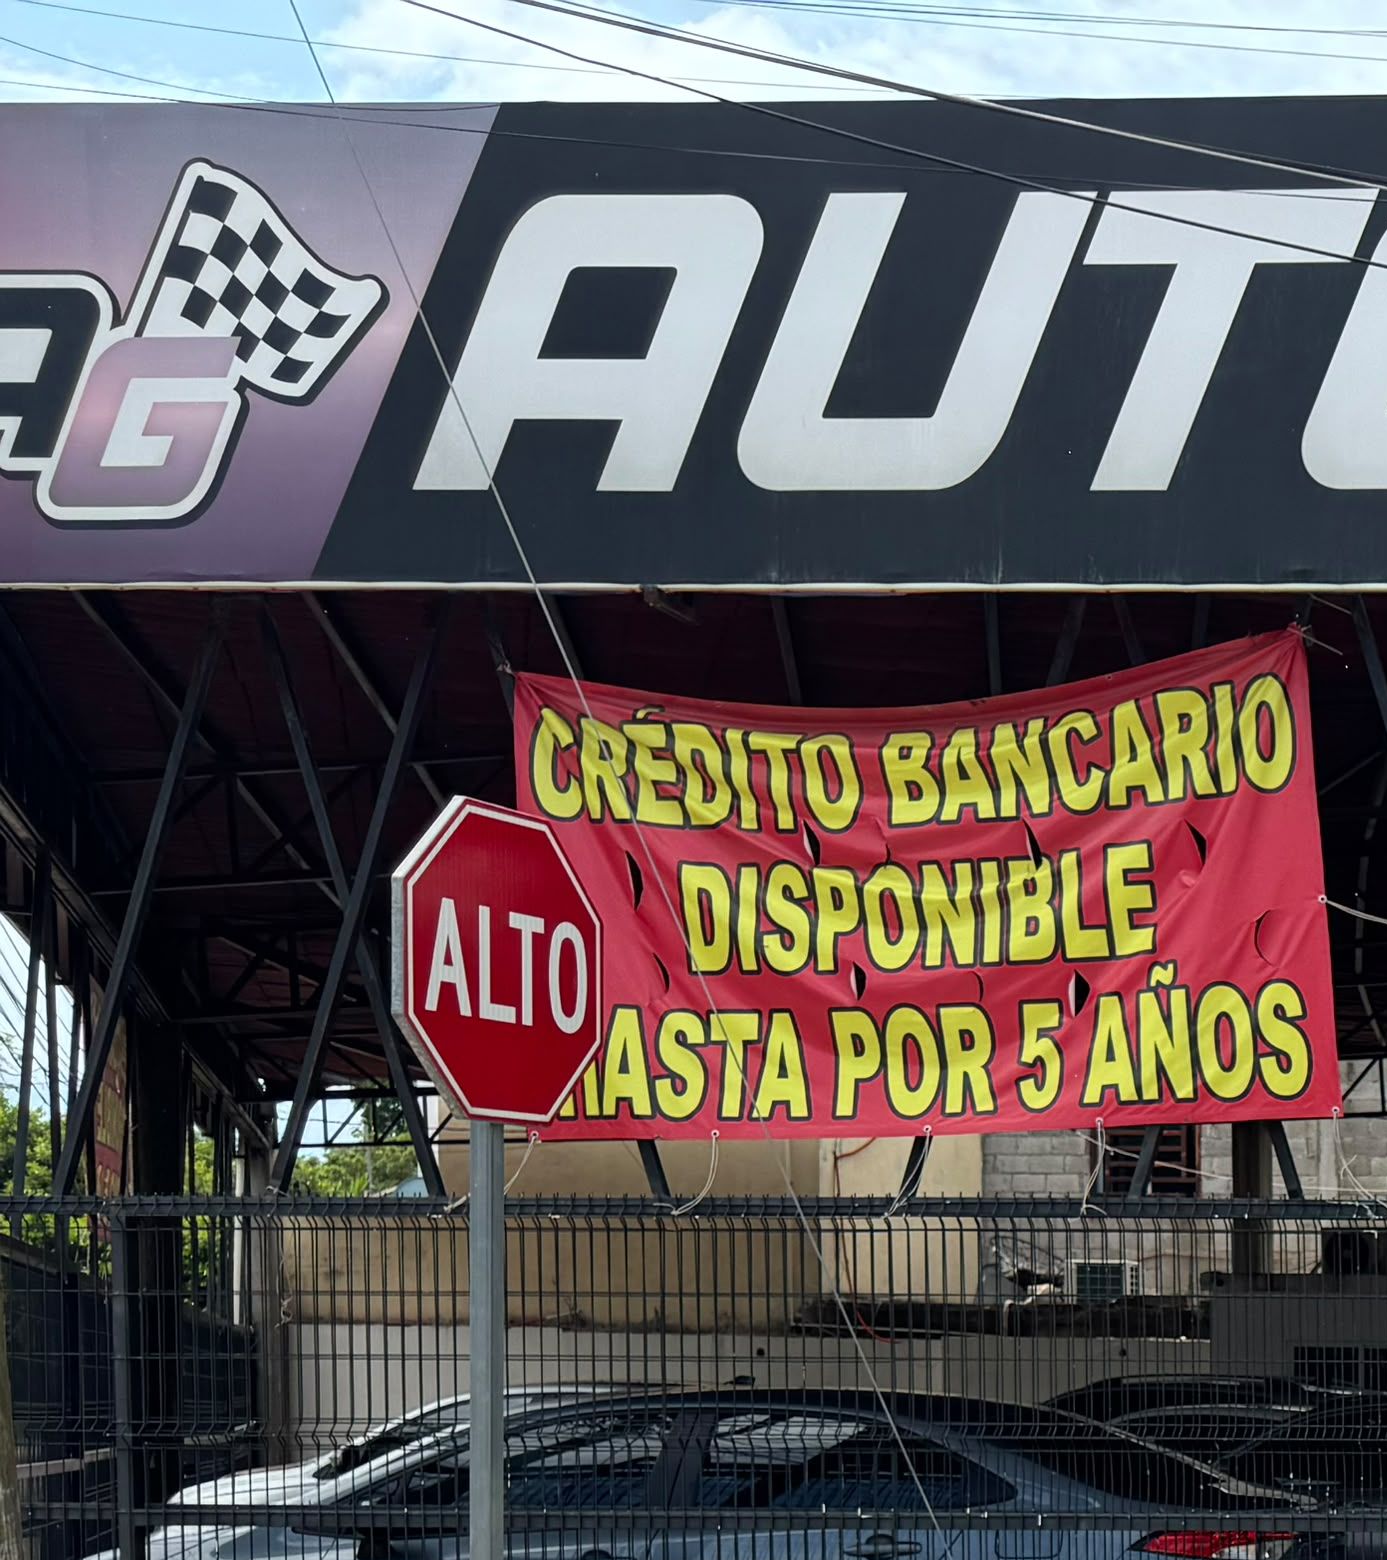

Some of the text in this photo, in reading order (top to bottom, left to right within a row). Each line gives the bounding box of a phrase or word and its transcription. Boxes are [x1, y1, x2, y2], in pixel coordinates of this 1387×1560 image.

[529, 672, 1298, 834] CRÉDITO BANCARIO
[425, 897, 588, 1034] ALTO
[677, 839, 1161, 977] DISPONIBLE
[557, 960, 1315, 1123] ASTA POR 5 AÑOS
